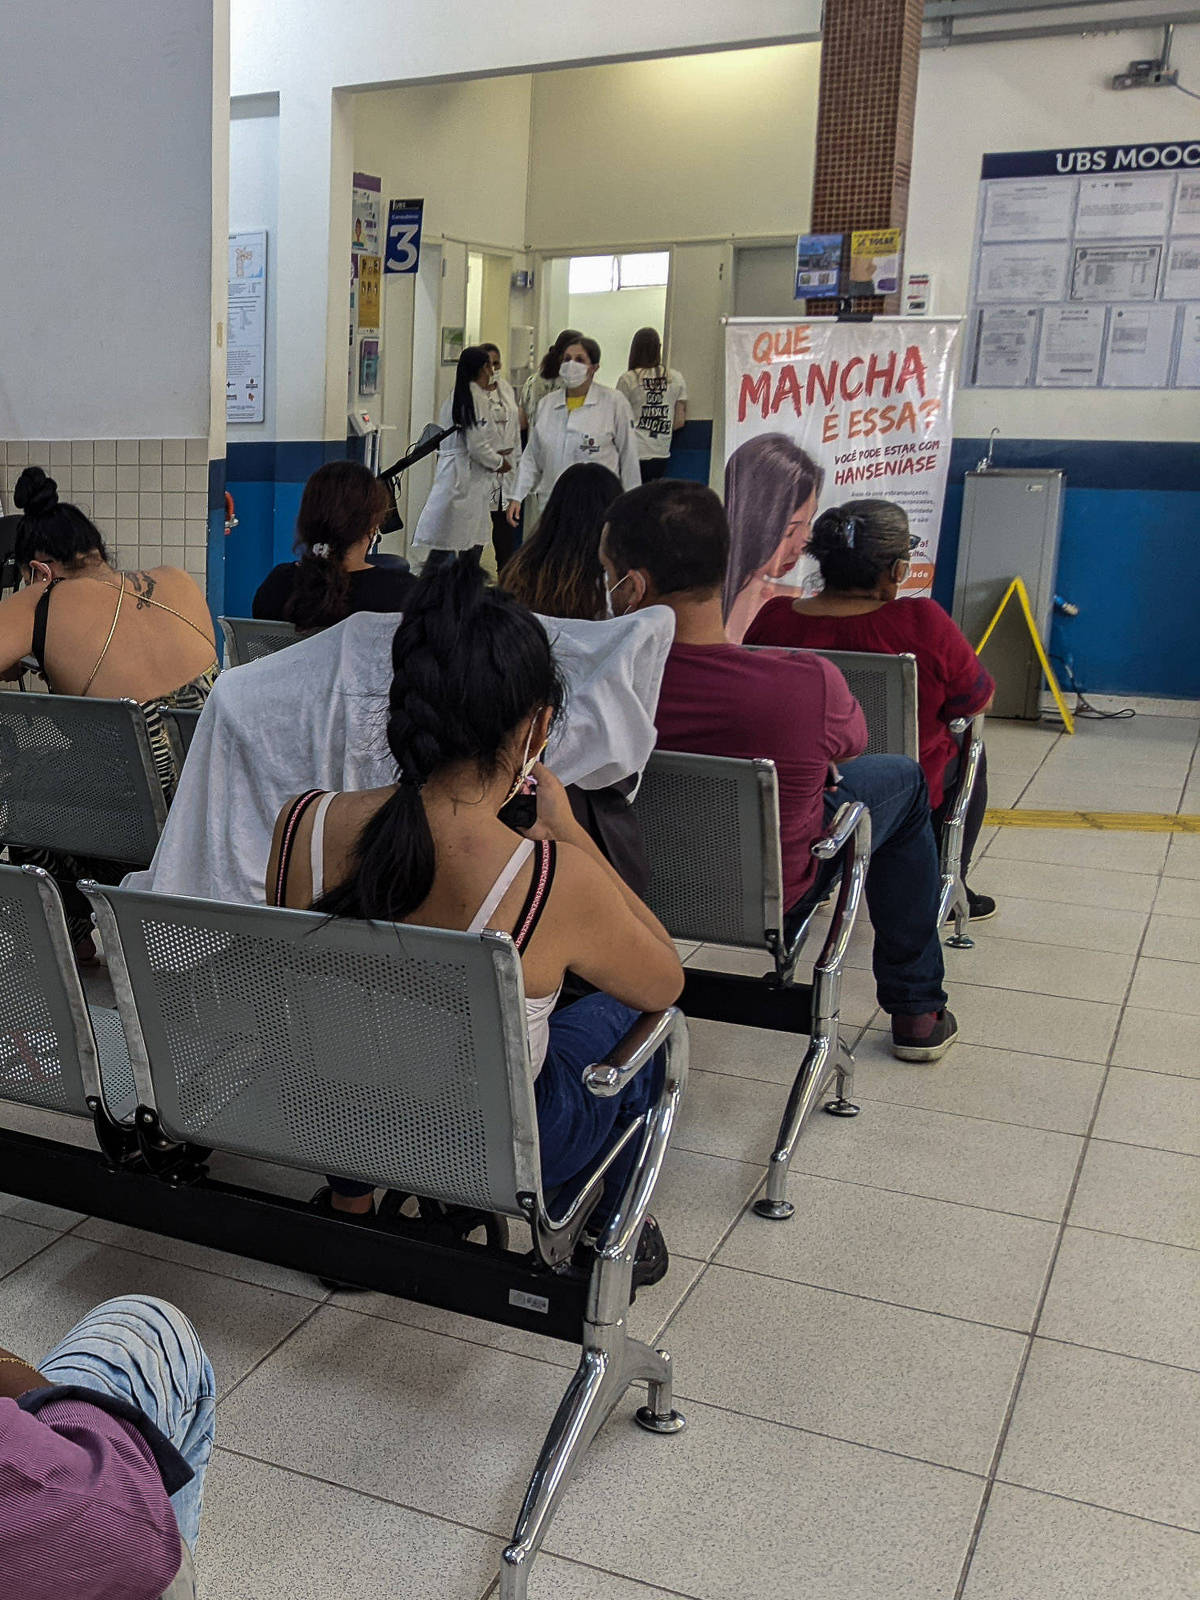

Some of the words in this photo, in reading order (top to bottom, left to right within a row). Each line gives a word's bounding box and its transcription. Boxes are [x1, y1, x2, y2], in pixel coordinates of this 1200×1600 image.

[1056, 151, 1106, 172] UBS
[387, 224, 419, 271] 3
[752, 325, 812, 365] QUE
[737, 345, 927, 423] MANCHA
[822, 405, 840, 444] É
[847, 398, 940, 440] ESSA?
[834, 449, 857, 465] VOCÊ
[859, 447, 882, 461] PODE
[884, 443, 917, 456] ESTAR
[918, 440, 940, 452] COM
[835, 453, 938, 486] HANSENÍASE
